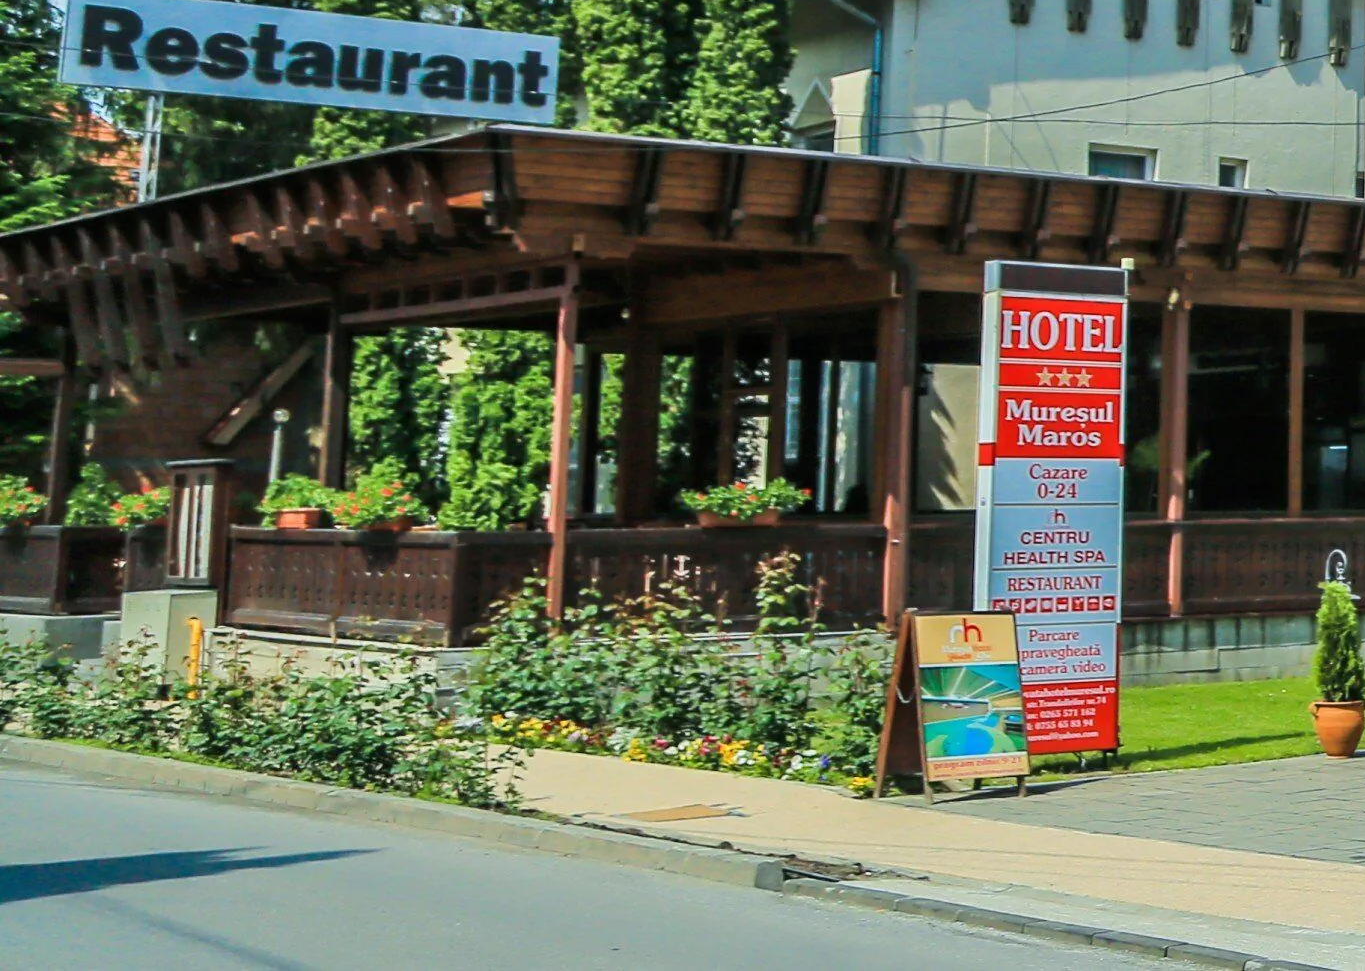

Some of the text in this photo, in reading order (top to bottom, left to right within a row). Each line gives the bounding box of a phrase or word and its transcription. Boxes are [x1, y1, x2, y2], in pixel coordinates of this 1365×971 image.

[79, 4, 549, 107] Restaurant
[1000, 310, 1122, 353] HOTEL
[1017, 425, 1102, 447] Maros
[1029, 464, 1088, 480] Cazare
[1037, 483, 1077, 499] 0-24
[1020, 531, 1090, 545] CENTRU
[1003, 550, 1106, 565] HEALTH SPA
[1007, 575, 1102, 592] RESTAURANT
[1029, 629, 1080, 642] Parcare
[1072, 660, 1106, 673] video
